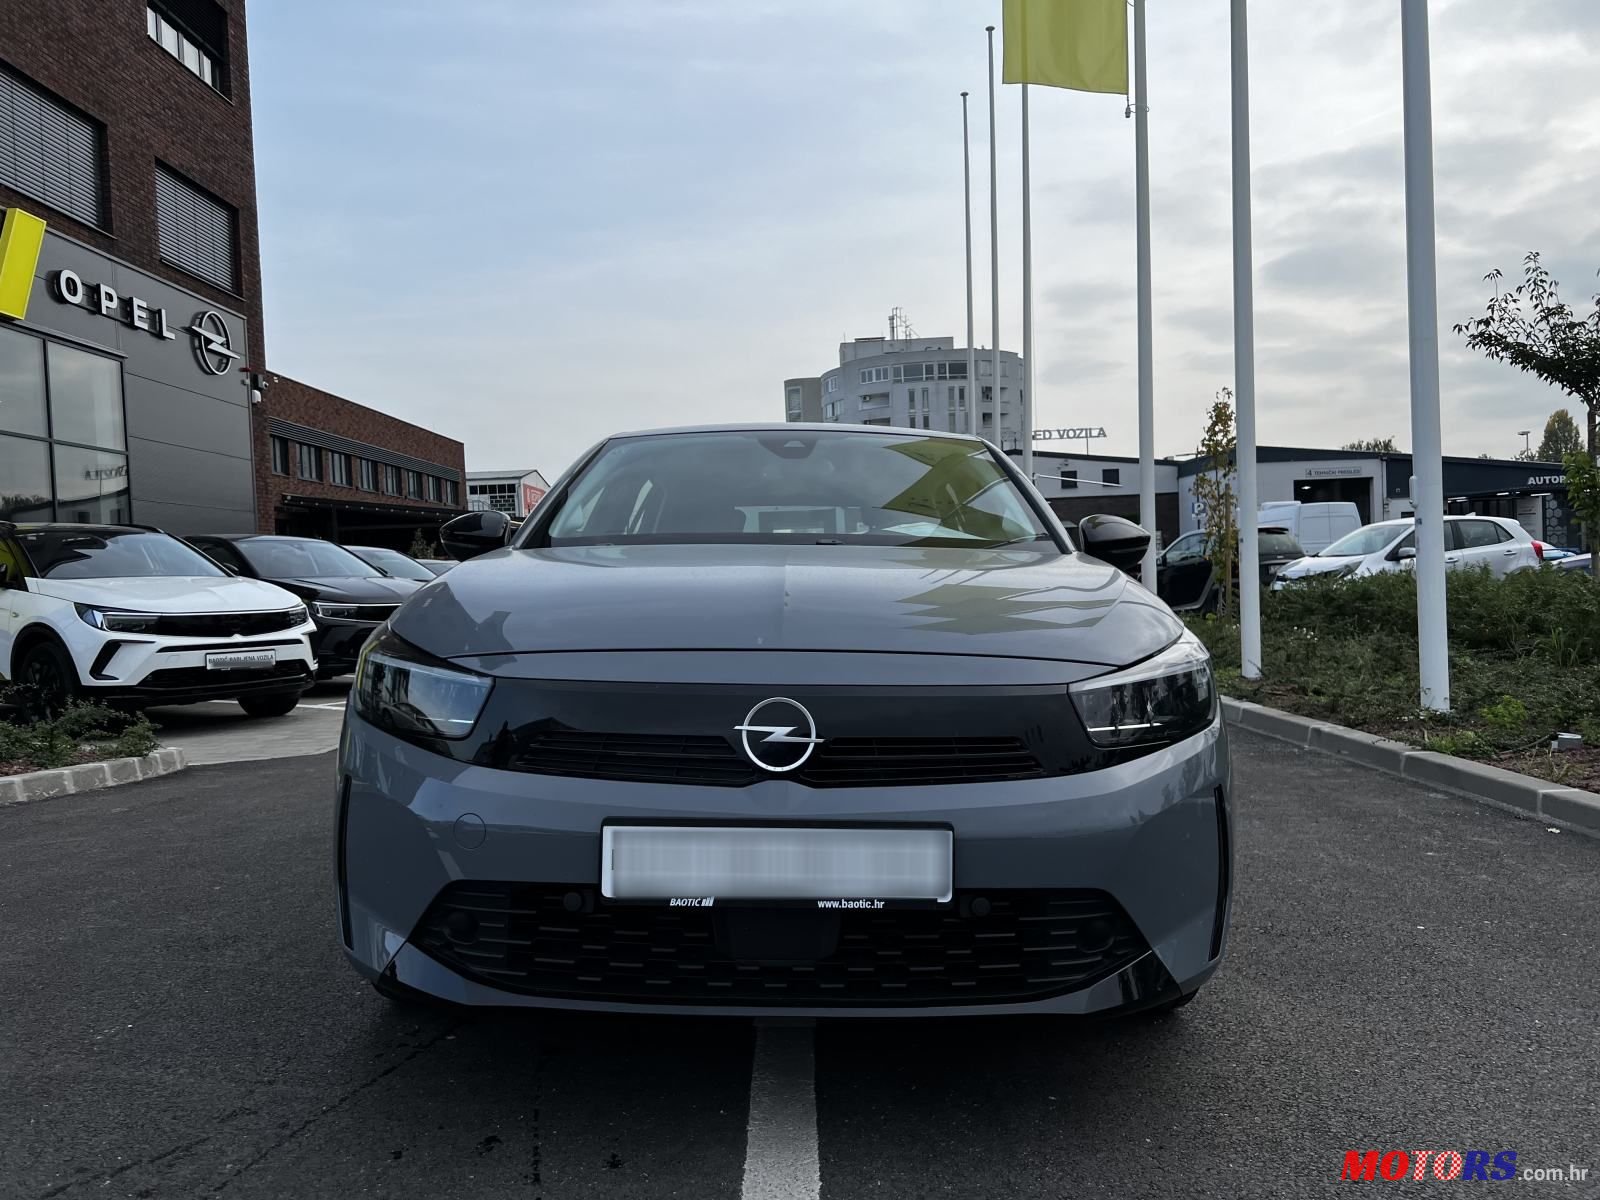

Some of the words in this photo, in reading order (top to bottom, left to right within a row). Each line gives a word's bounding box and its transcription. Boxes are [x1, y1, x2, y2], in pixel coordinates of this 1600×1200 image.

[59, 269, 176, 340] OPEL
[1032, 430, 1052, 440] ED
[1057, 427, 1107, 439] VOZILA
[1528, 475, 1566, 485] AUTOP
[1194, 502, 1204, 514] P
[817, 898, 885, 909] www.baotic.hr
